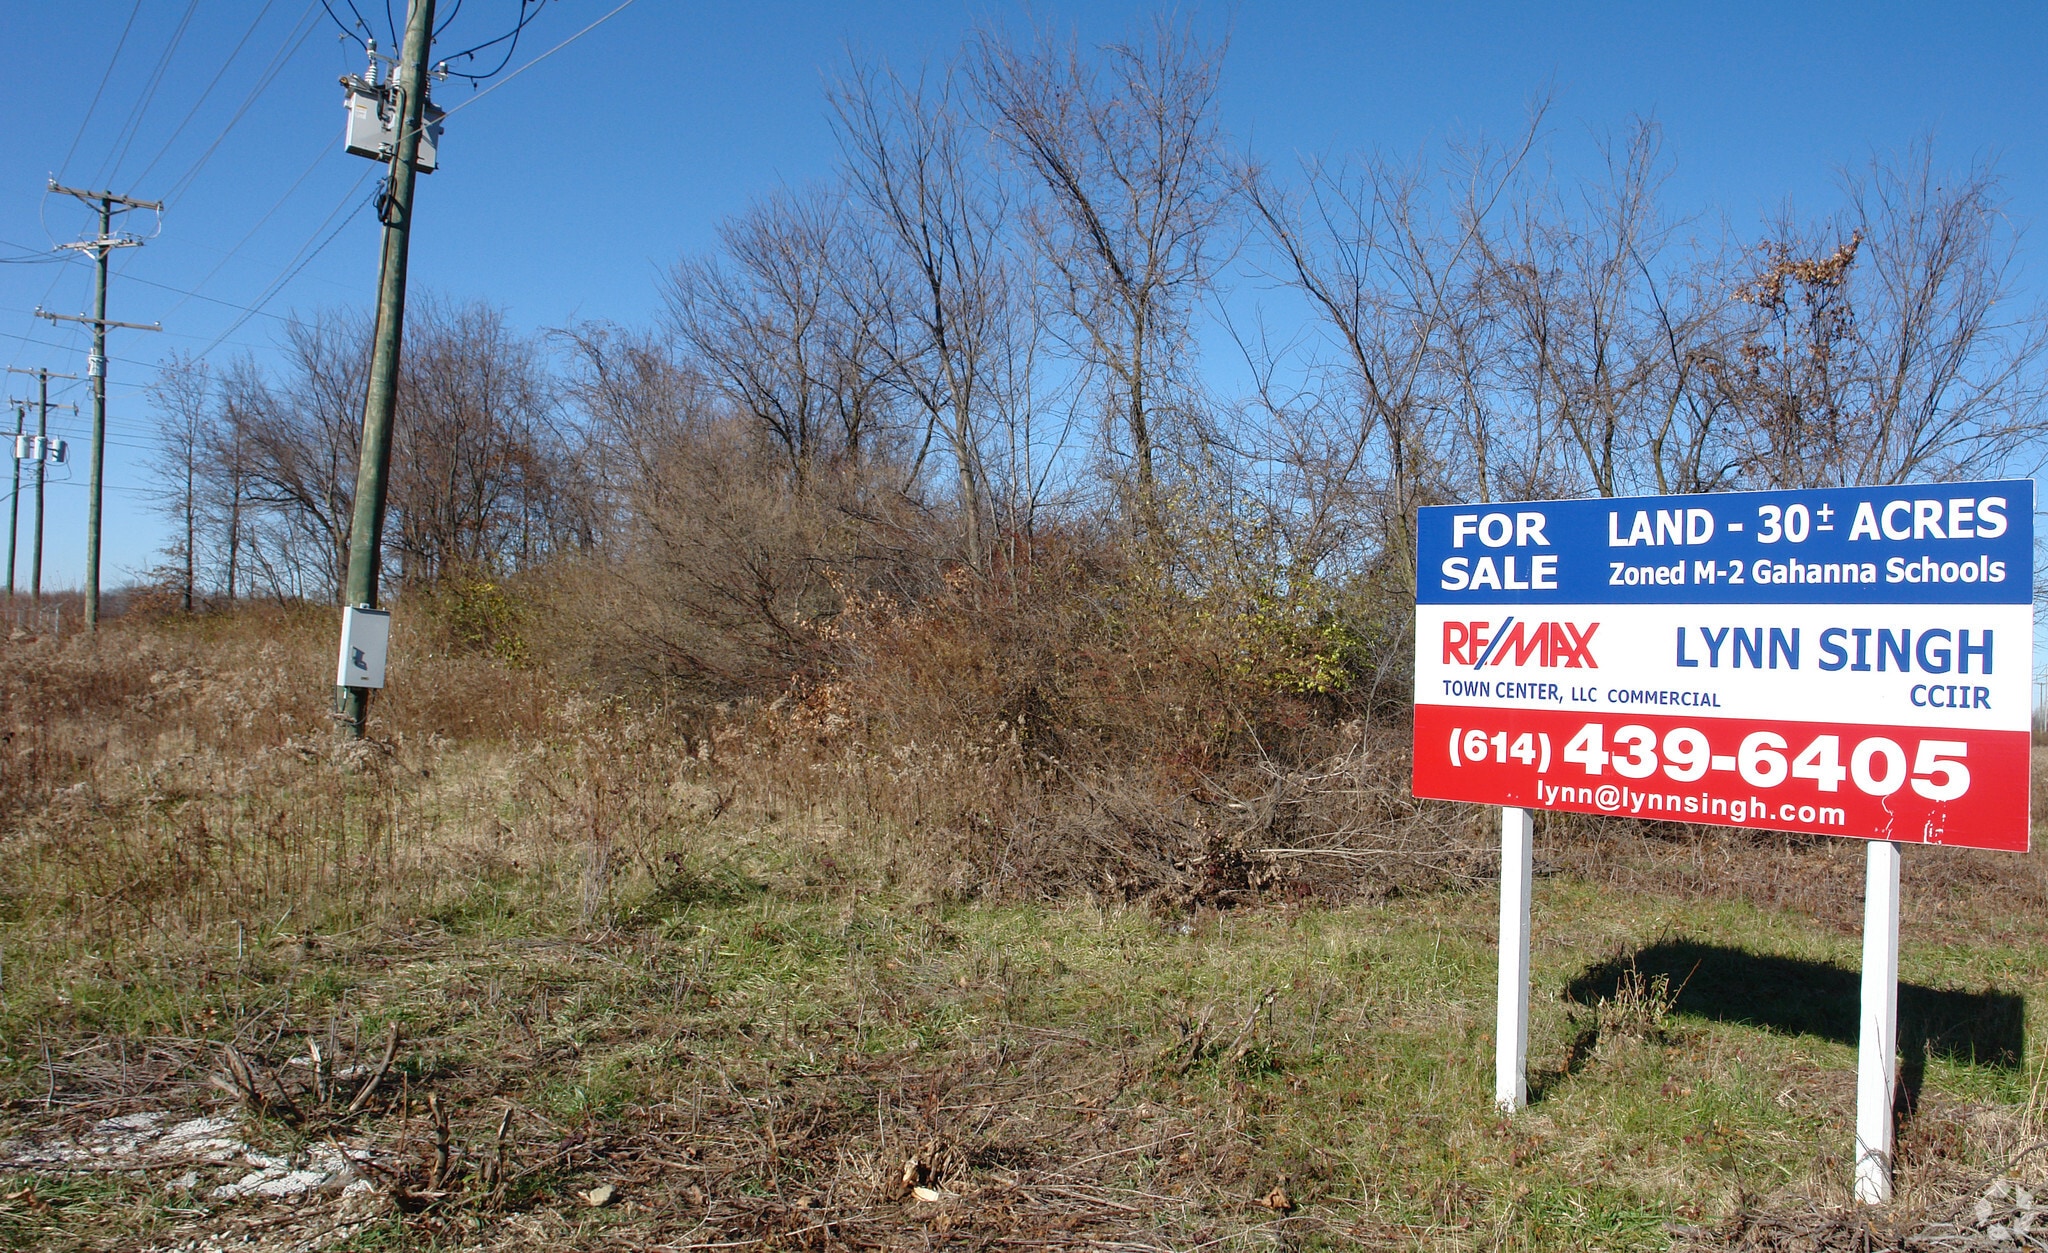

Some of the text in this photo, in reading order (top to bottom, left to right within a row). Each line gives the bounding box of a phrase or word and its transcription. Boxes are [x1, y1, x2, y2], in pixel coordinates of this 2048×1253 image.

[1453, 511, 1551, 548] FOR
[1608, 508, 1715, 547] LAND
[1727, 522, 1743, 532] -
[1848, 497, 2008, 541] ACRES
[1441, 554, 1558, 591] SALE
[1609, 554, 2006, 586] Zoned M-2 Gahanna Schools
[1442, 616, 1601, 671] RE/MAX
[1676, 626, 1994, 675] LYNN SINGH
[1442, 679, 1721, 708] TOWN CENTER, LLC COMMERCIAL
[1910, 684, 1992, 710] CCIIR
[1449, 722, 1971, 803] (614) 439-6405
[1537, 779, 1845, 826] lynn@lynnsingh.com
